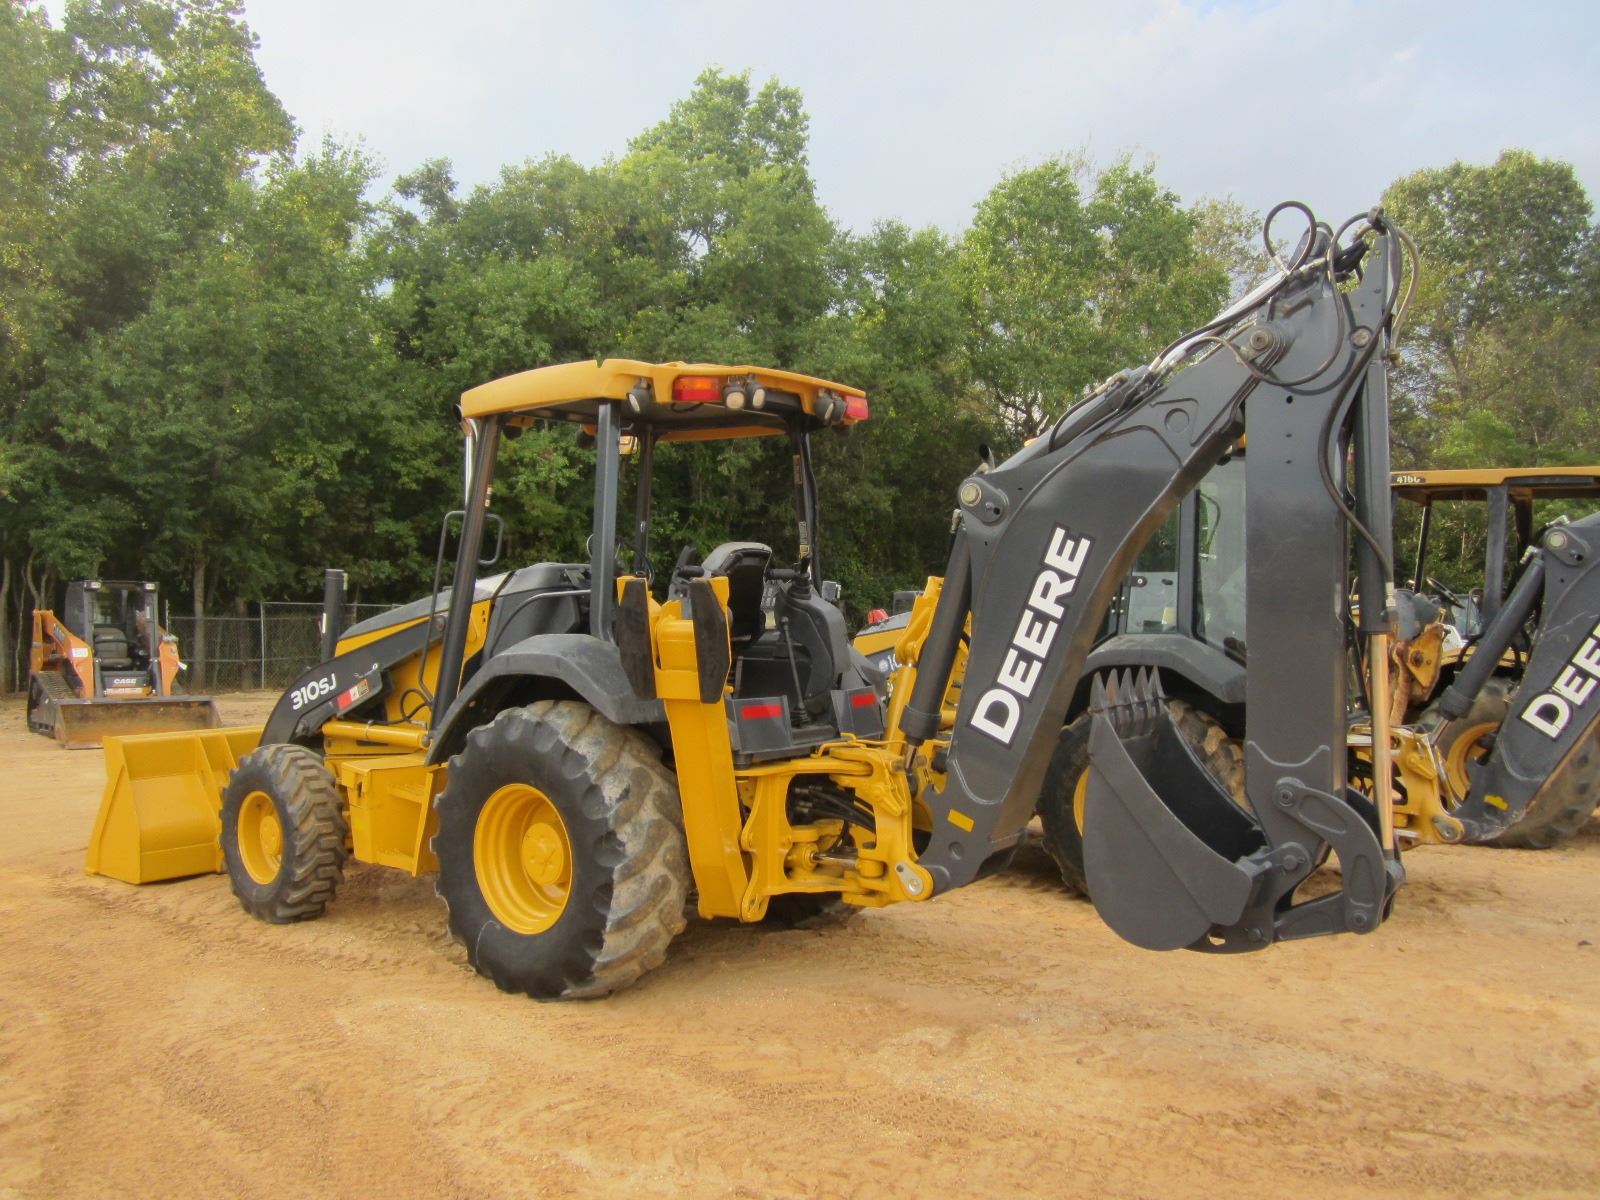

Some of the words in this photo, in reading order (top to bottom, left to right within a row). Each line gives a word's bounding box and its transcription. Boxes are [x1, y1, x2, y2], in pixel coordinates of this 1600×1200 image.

[290, 673, 337, 710] 310SJ
[970, 527, 1091, 745] DEERE
[1521, 623, 1600, 738] DEE
